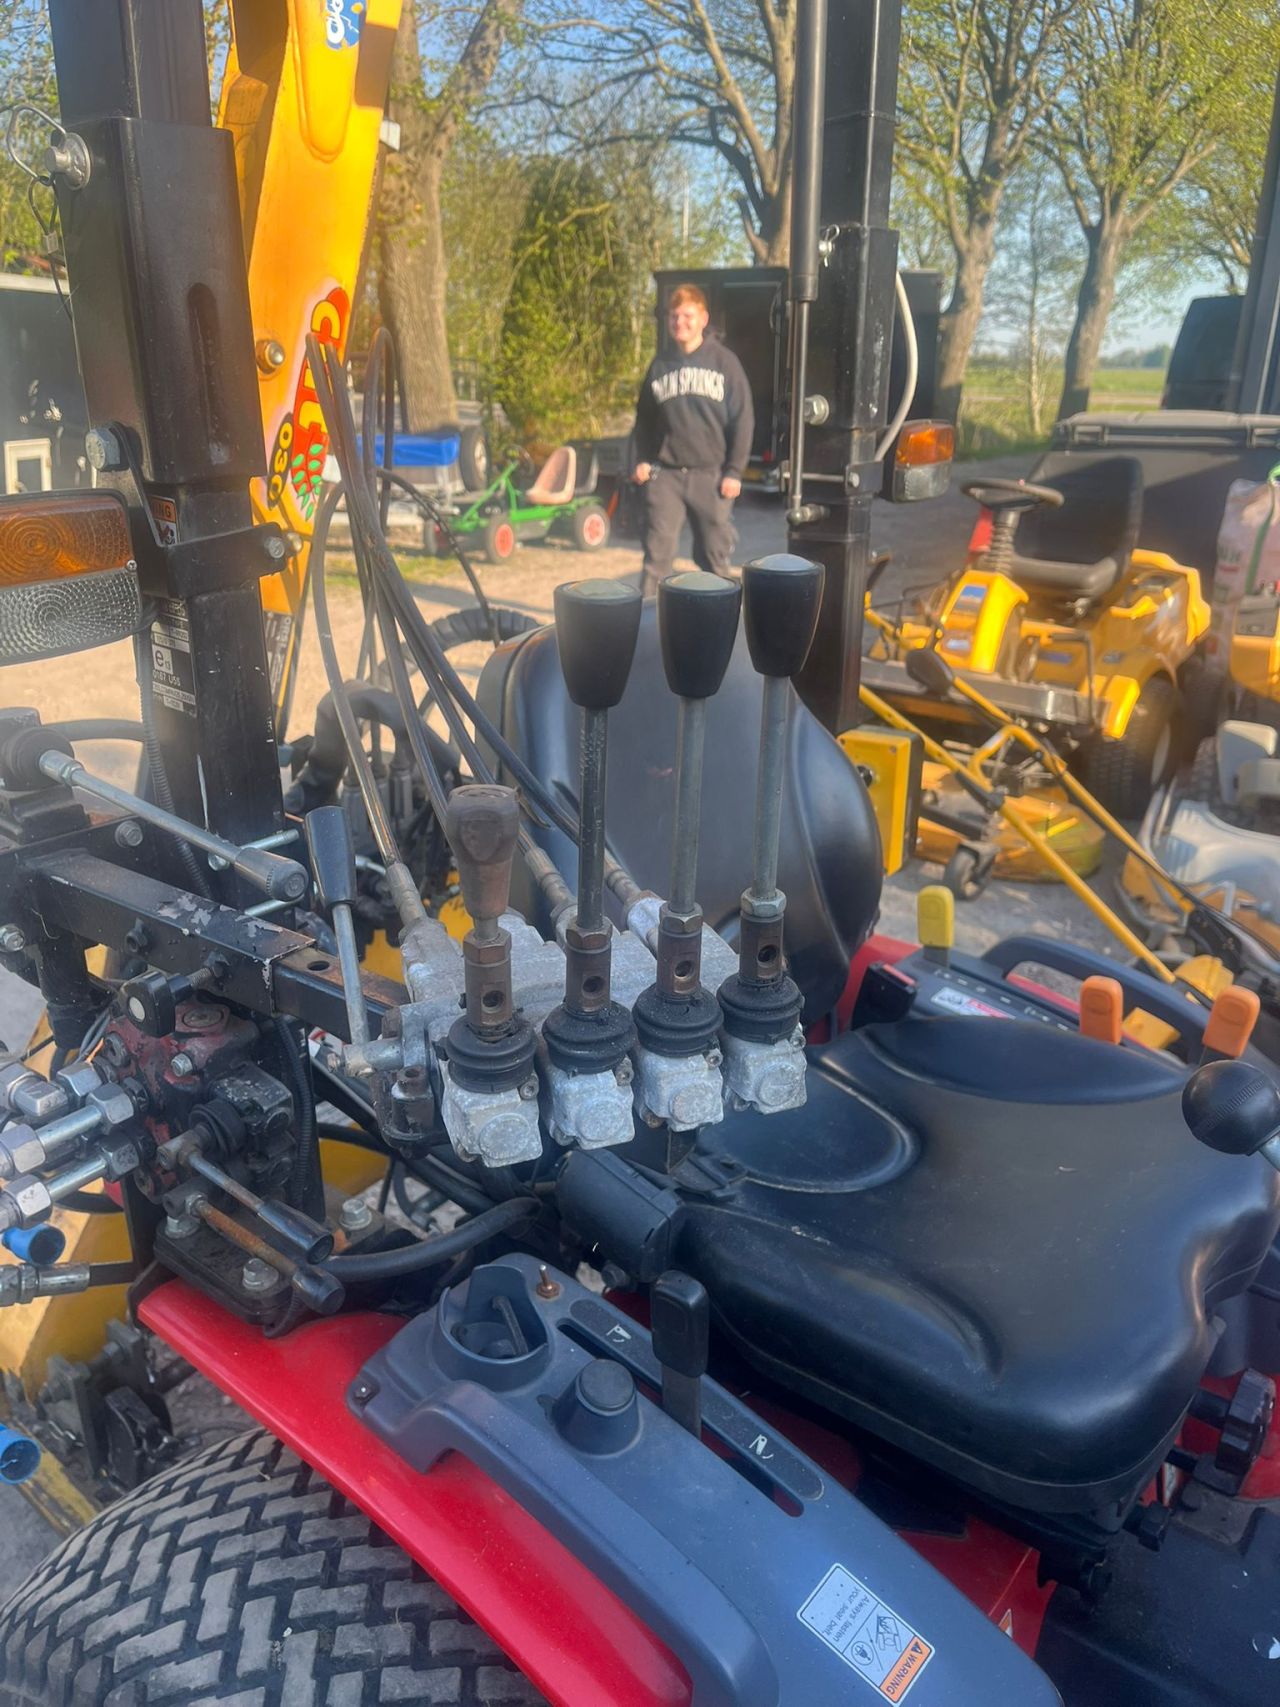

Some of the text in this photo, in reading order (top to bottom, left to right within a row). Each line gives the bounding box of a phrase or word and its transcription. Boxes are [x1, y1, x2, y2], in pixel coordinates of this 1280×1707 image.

[848, 1586, 861, 1604] your
[832, 1594, 870, 1642] Always fasten
[835, 1603, 849, 1620] seat
[886, 1654, 917, 1695] WARNING
